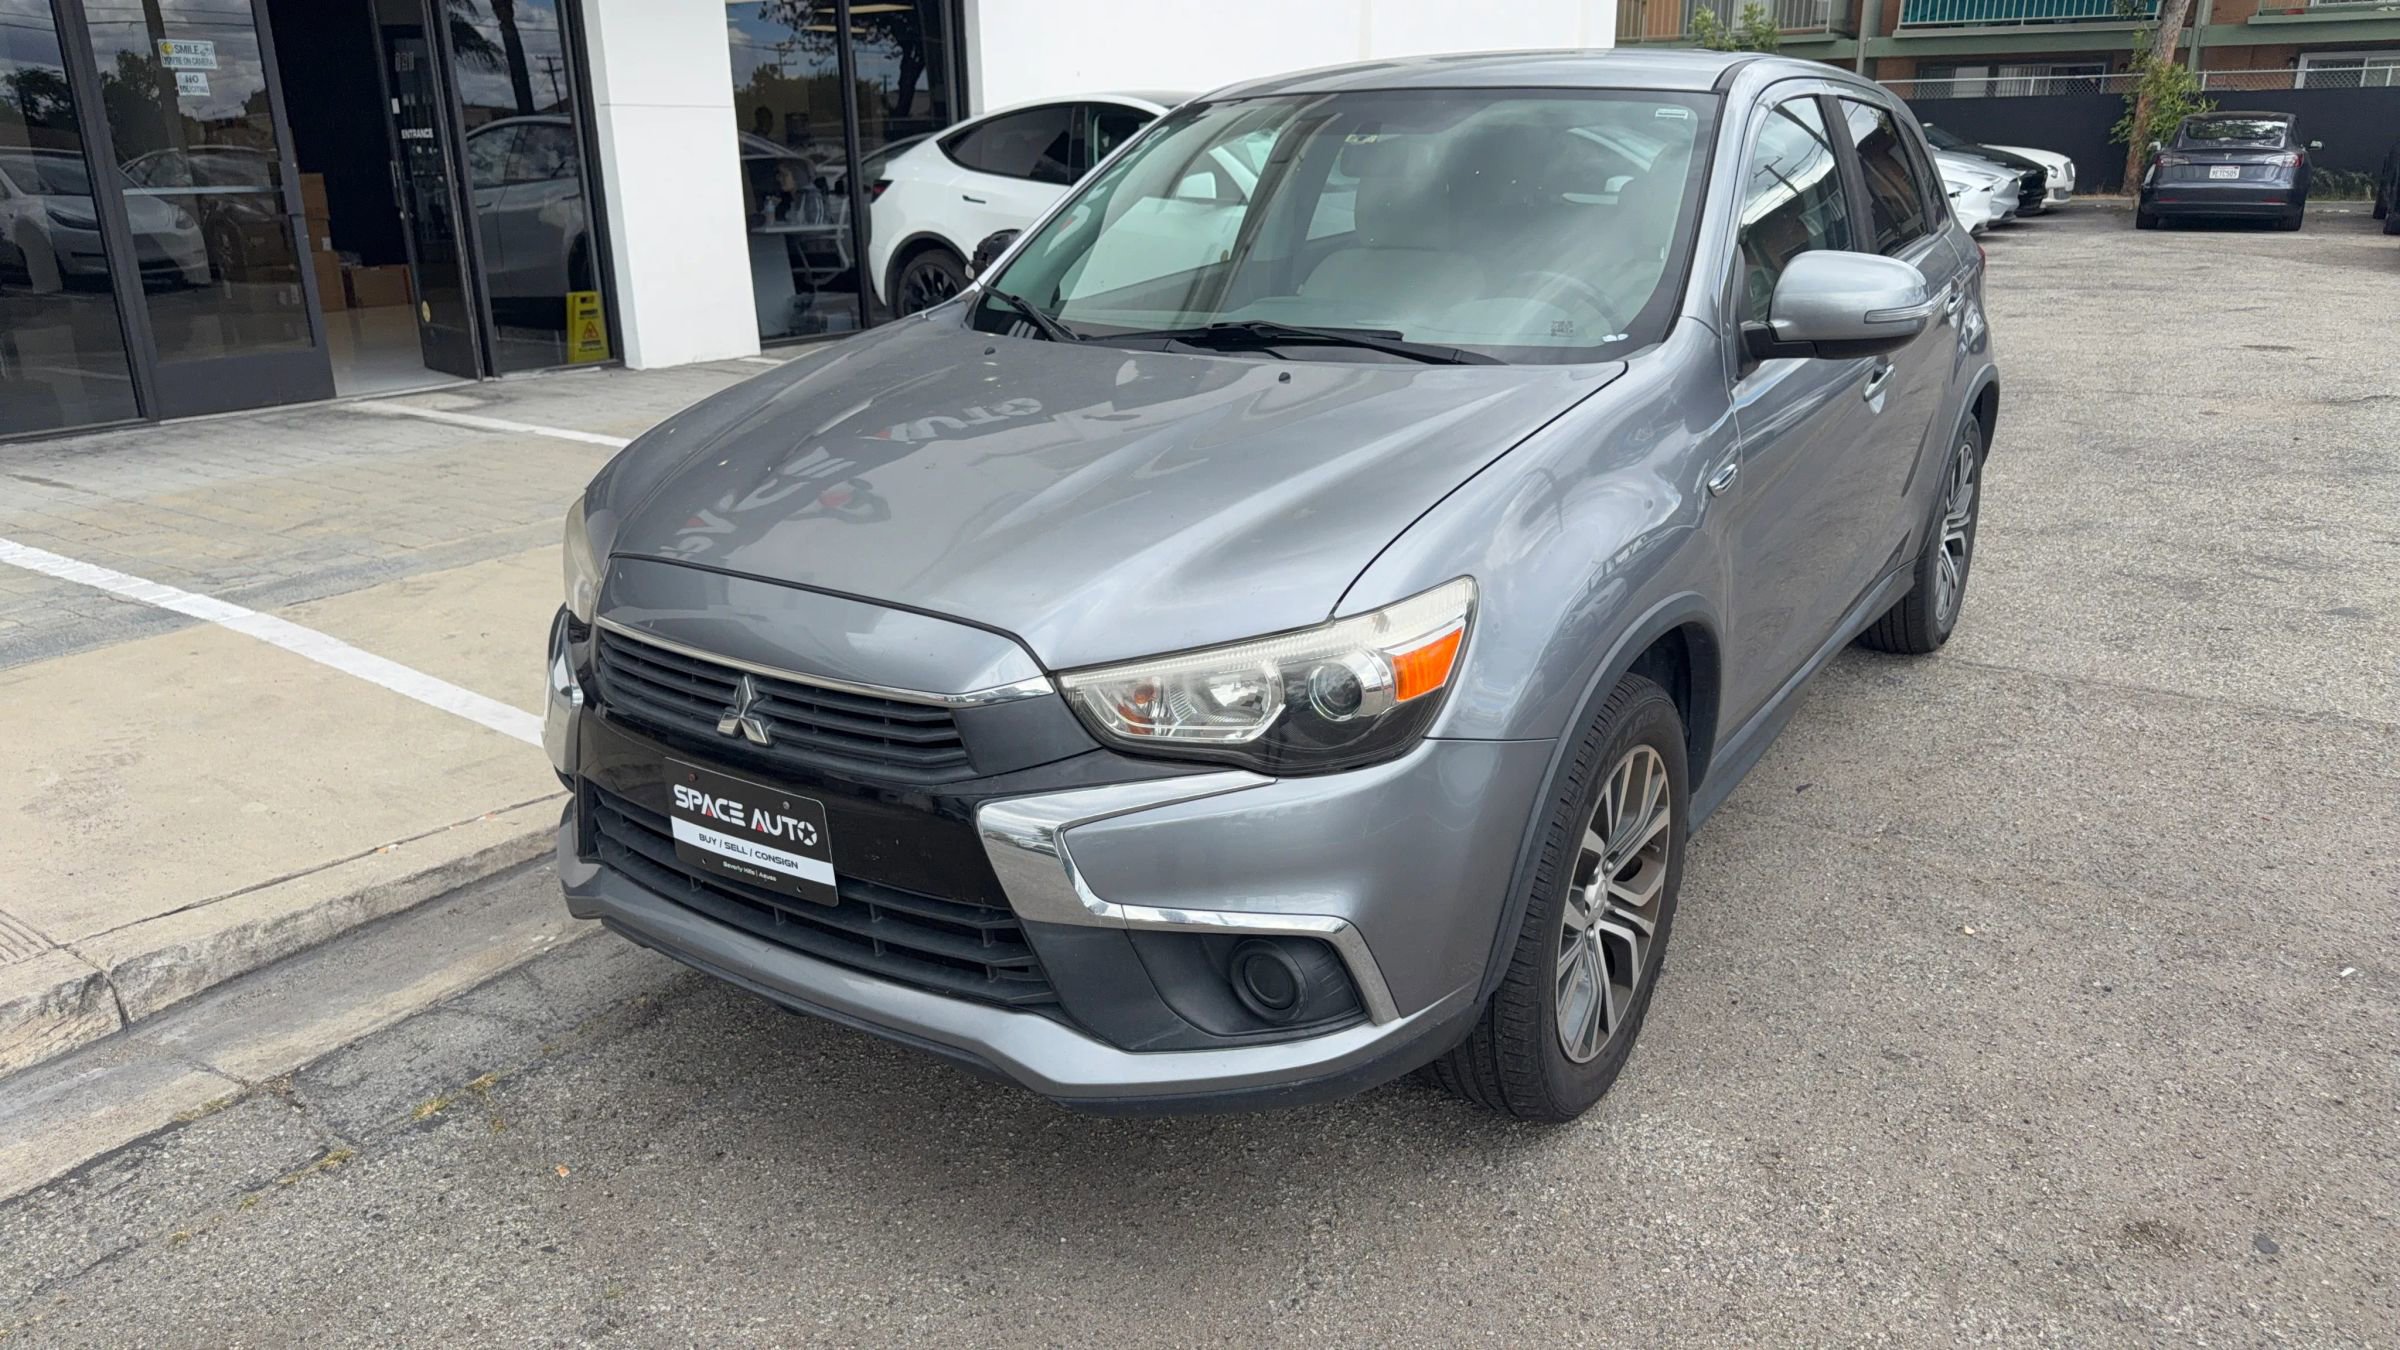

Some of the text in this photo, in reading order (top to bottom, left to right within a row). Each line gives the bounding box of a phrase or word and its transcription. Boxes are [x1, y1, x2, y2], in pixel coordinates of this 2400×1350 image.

[174, 44, 199, 55] SMILE
[183, 57, 192, 65] ON
[185, 75, 199, 83] NO
[401, 128, 434, 139] ENTRANCE
[673, 783, 818, 846] SPACE AUTO
[698, 833, 717, 846] BUY
[724, 841, 748, 855] SELL
[755, 850, 799, 869] CONSIGN
[722, 860, 743, 873] Beverly
[743, 867, 755, 876] Hills
